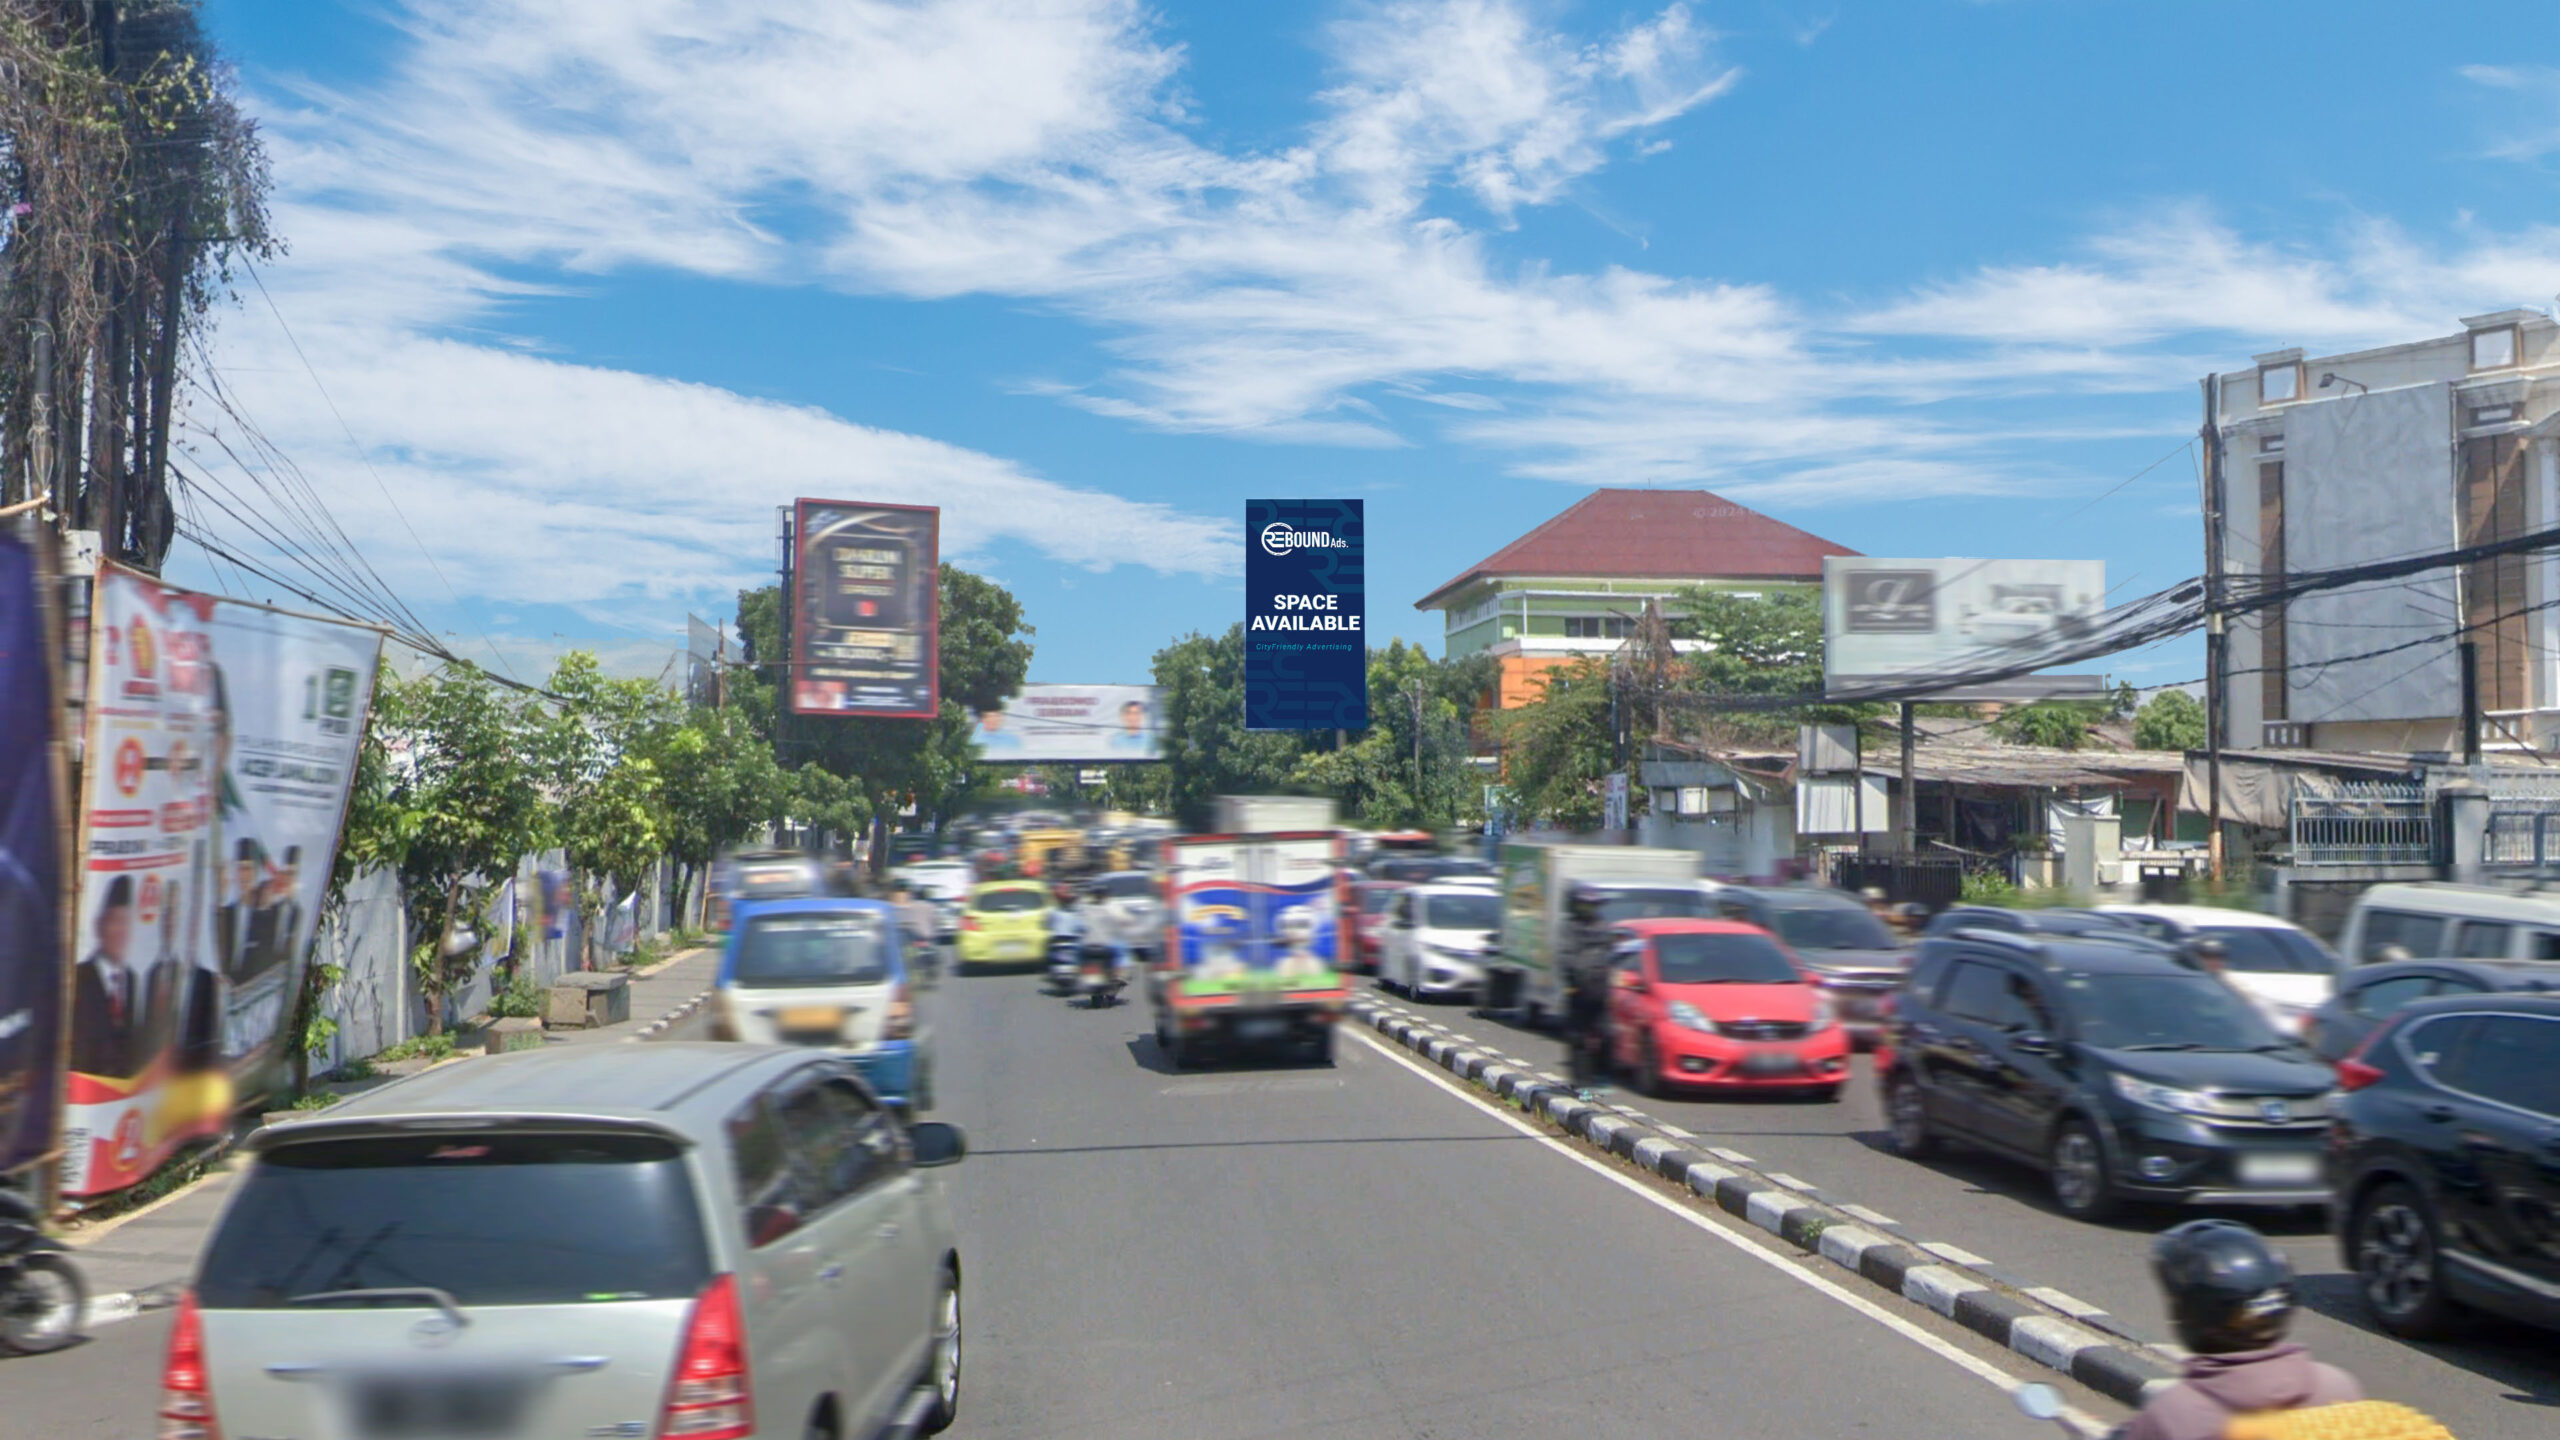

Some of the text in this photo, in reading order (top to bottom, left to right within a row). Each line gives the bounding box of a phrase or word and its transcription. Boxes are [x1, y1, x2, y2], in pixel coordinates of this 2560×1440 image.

[1262, 529, 1349, 550] REBOUND Ads.
[1273, 594, 1338, 610] SPACE
[1250, 615, 1361, 631] AVAILABLE
[1255, 643, 1353, 652] CityFriendly Advertising
